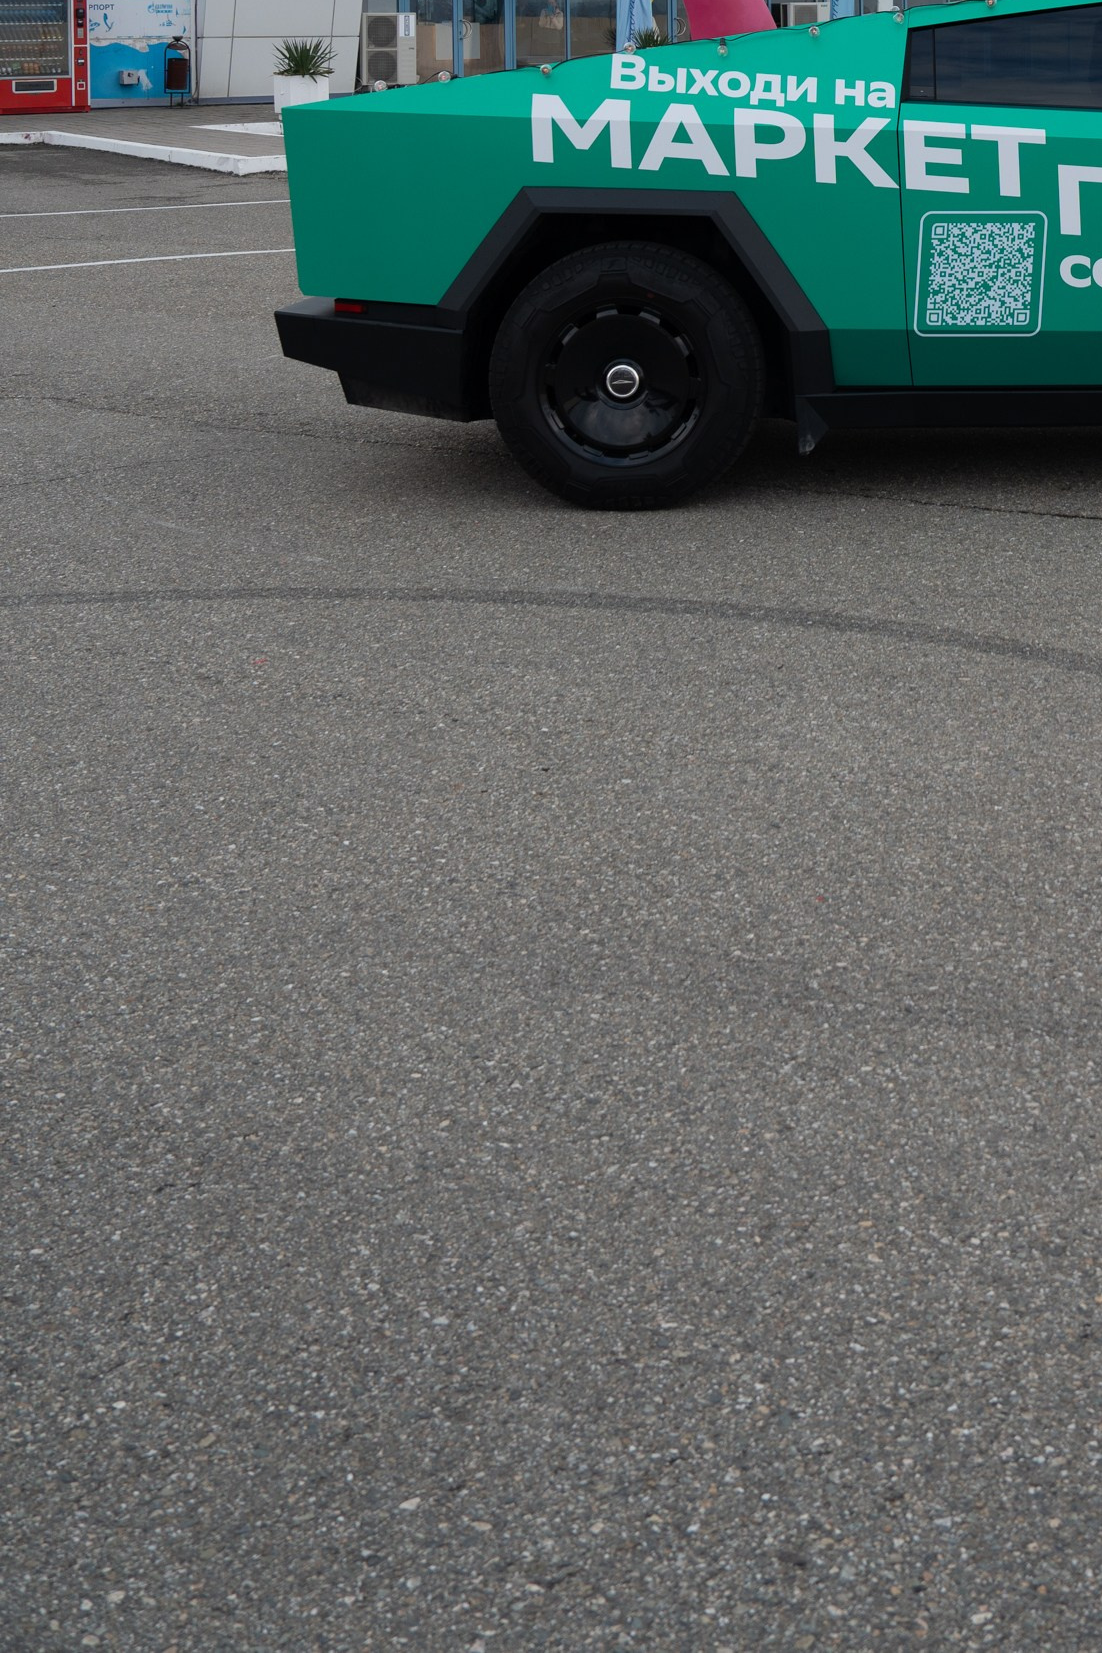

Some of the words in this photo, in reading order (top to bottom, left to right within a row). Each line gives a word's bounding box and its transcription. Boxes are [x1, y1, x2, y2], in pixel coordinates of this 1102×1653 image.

[609, 52, 818, 107] Выходи
[835, 78, 896, 109] на
[531, 93, 1047, 197] МАРКЕТ
